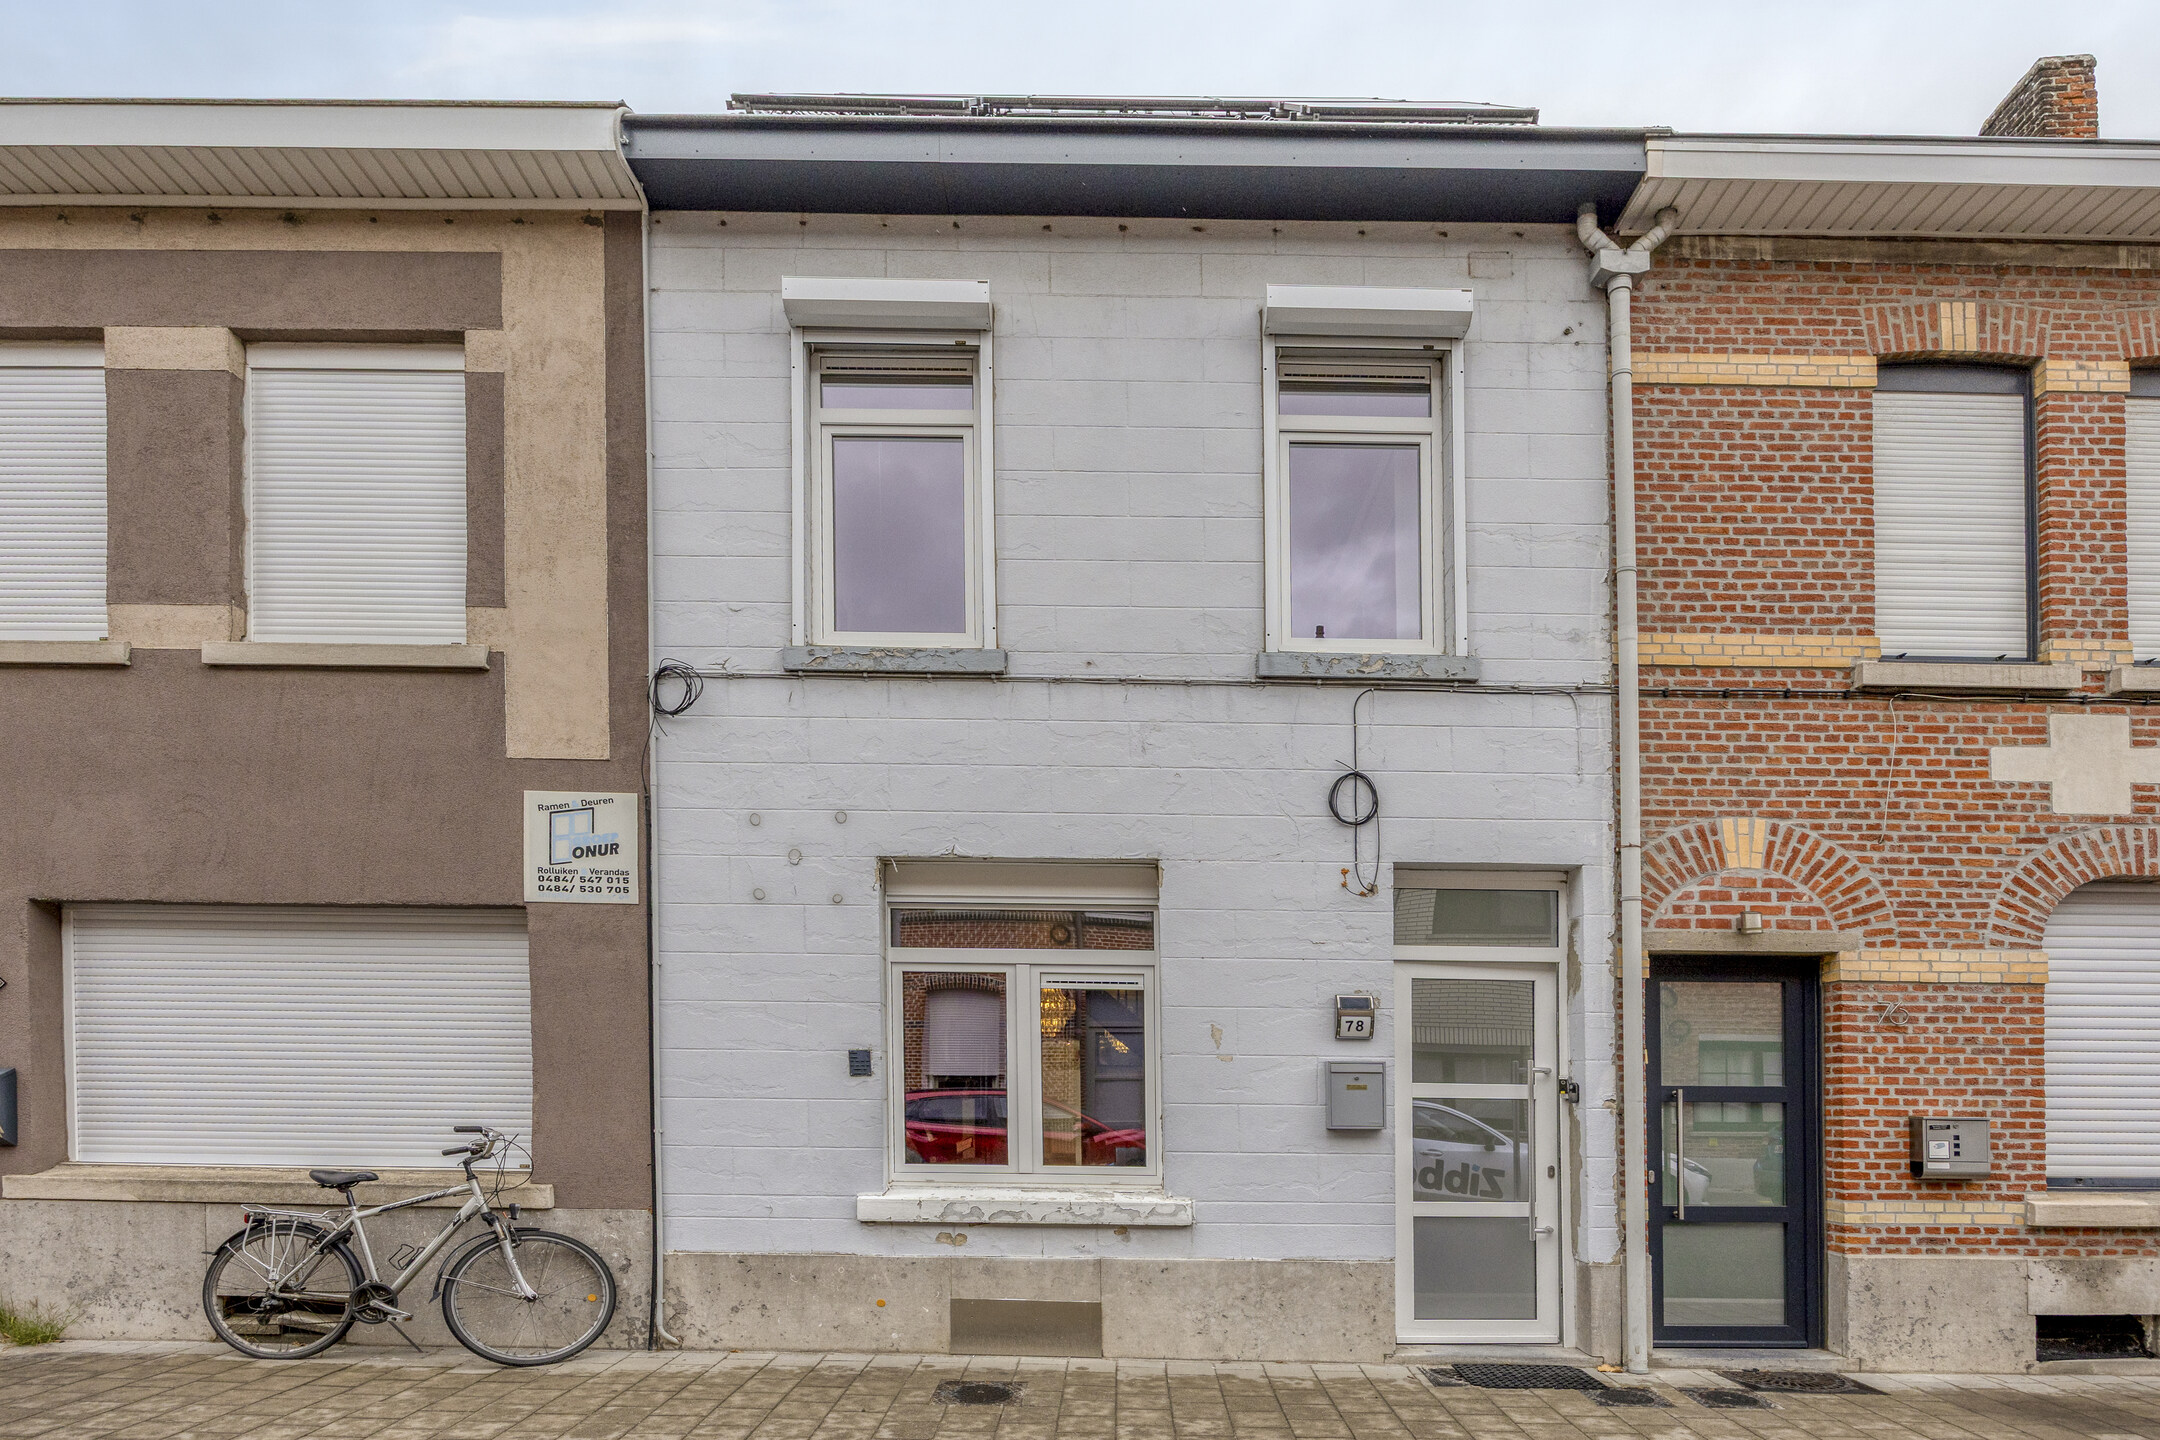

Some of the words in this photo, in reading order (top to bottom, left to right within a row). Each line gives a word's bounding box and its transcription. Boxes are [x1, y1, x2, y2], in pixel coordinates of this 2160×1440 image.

[538, 802, 570, 811] Ramen
[581, 798, 614, 807] Deuren
[572, 843, 620, 859] ONUR
[537, 867, 579, 875] Rolluiken
[589, 868, 630, 876] Verandas
[538, 875, 575, 884] 0484/
[579, 876, 602, 884] 547
[538, 884, 575, 893] 0484/
[579, 885, 602, 893] 530
[606, 886, 630, 894] 705
[1877, 1001, 1909, 1025] 76
[1345, 1020, 1364, 1032] 78
